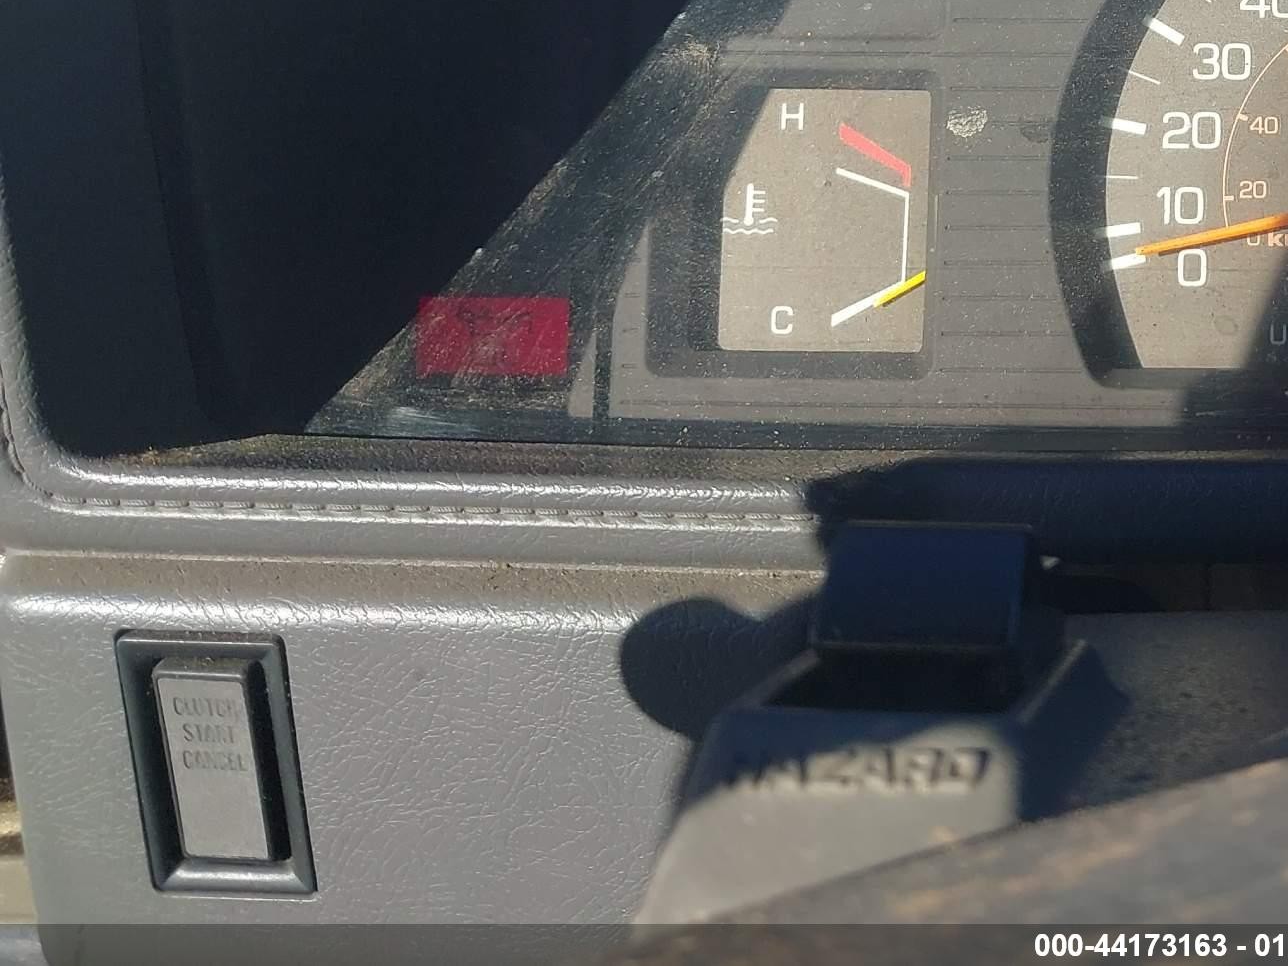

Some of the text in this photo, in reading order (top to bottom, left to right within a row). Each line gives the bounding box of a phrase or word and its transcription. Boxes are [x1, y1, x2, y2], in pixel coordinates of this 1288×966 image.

[1192, 42, 1252, 81] 30
[779, 102, 805, 131] H
[1161, 111, 1222, 150] 20
[1249, 116, 1279, 135] 40
[1156, 186, 1204, 225] 10
[1239, 180, 1268, 199] 20
[1177, 248, 1208, 287] 0
[769, 305, 794, 335] C
